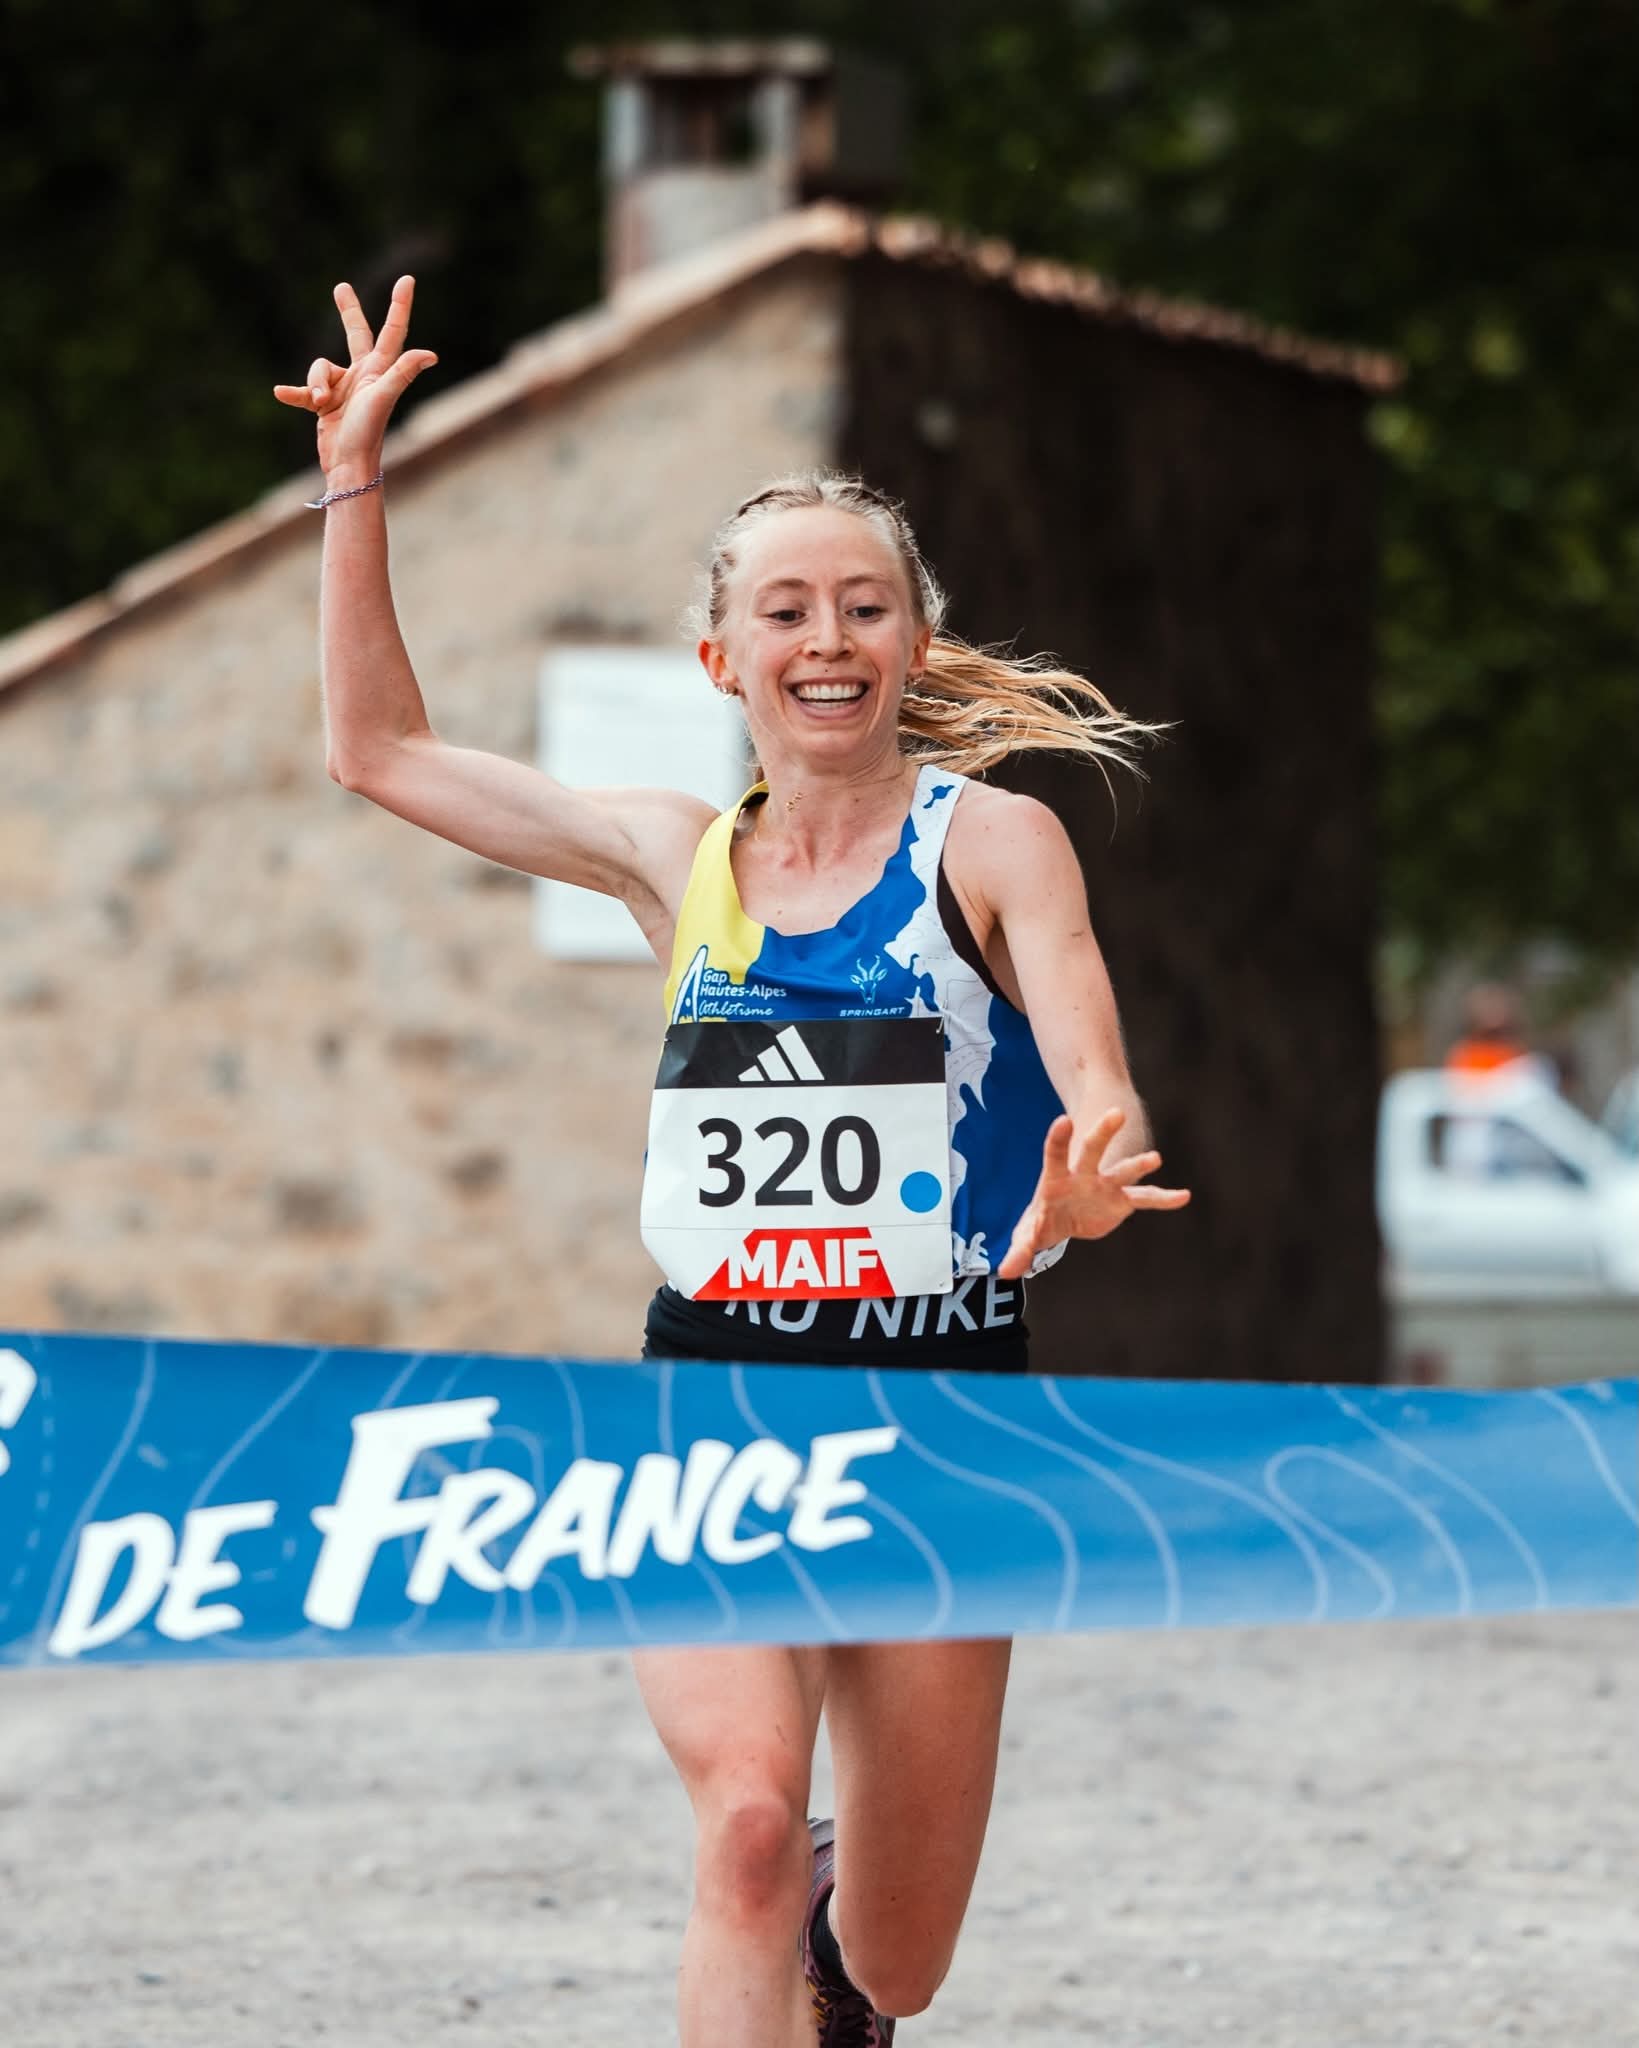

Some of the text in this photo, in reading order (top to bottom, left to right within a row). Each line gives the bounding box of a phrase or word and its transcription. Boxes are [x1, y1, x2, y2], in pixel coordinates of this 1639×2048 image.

[700, 984, 787, 1000] Hautes-Alpes
[703, 970, 727, 985] Gap
[839, 1007, 905, 1017] SPRINGART
[698, 1115, 881, 1208] 320
[727, 1237, 879, 1289] MAIF
[849, 1275, 1016, 1339] NIKE
[46, 1396, 899, 1659] DE FRANCE
